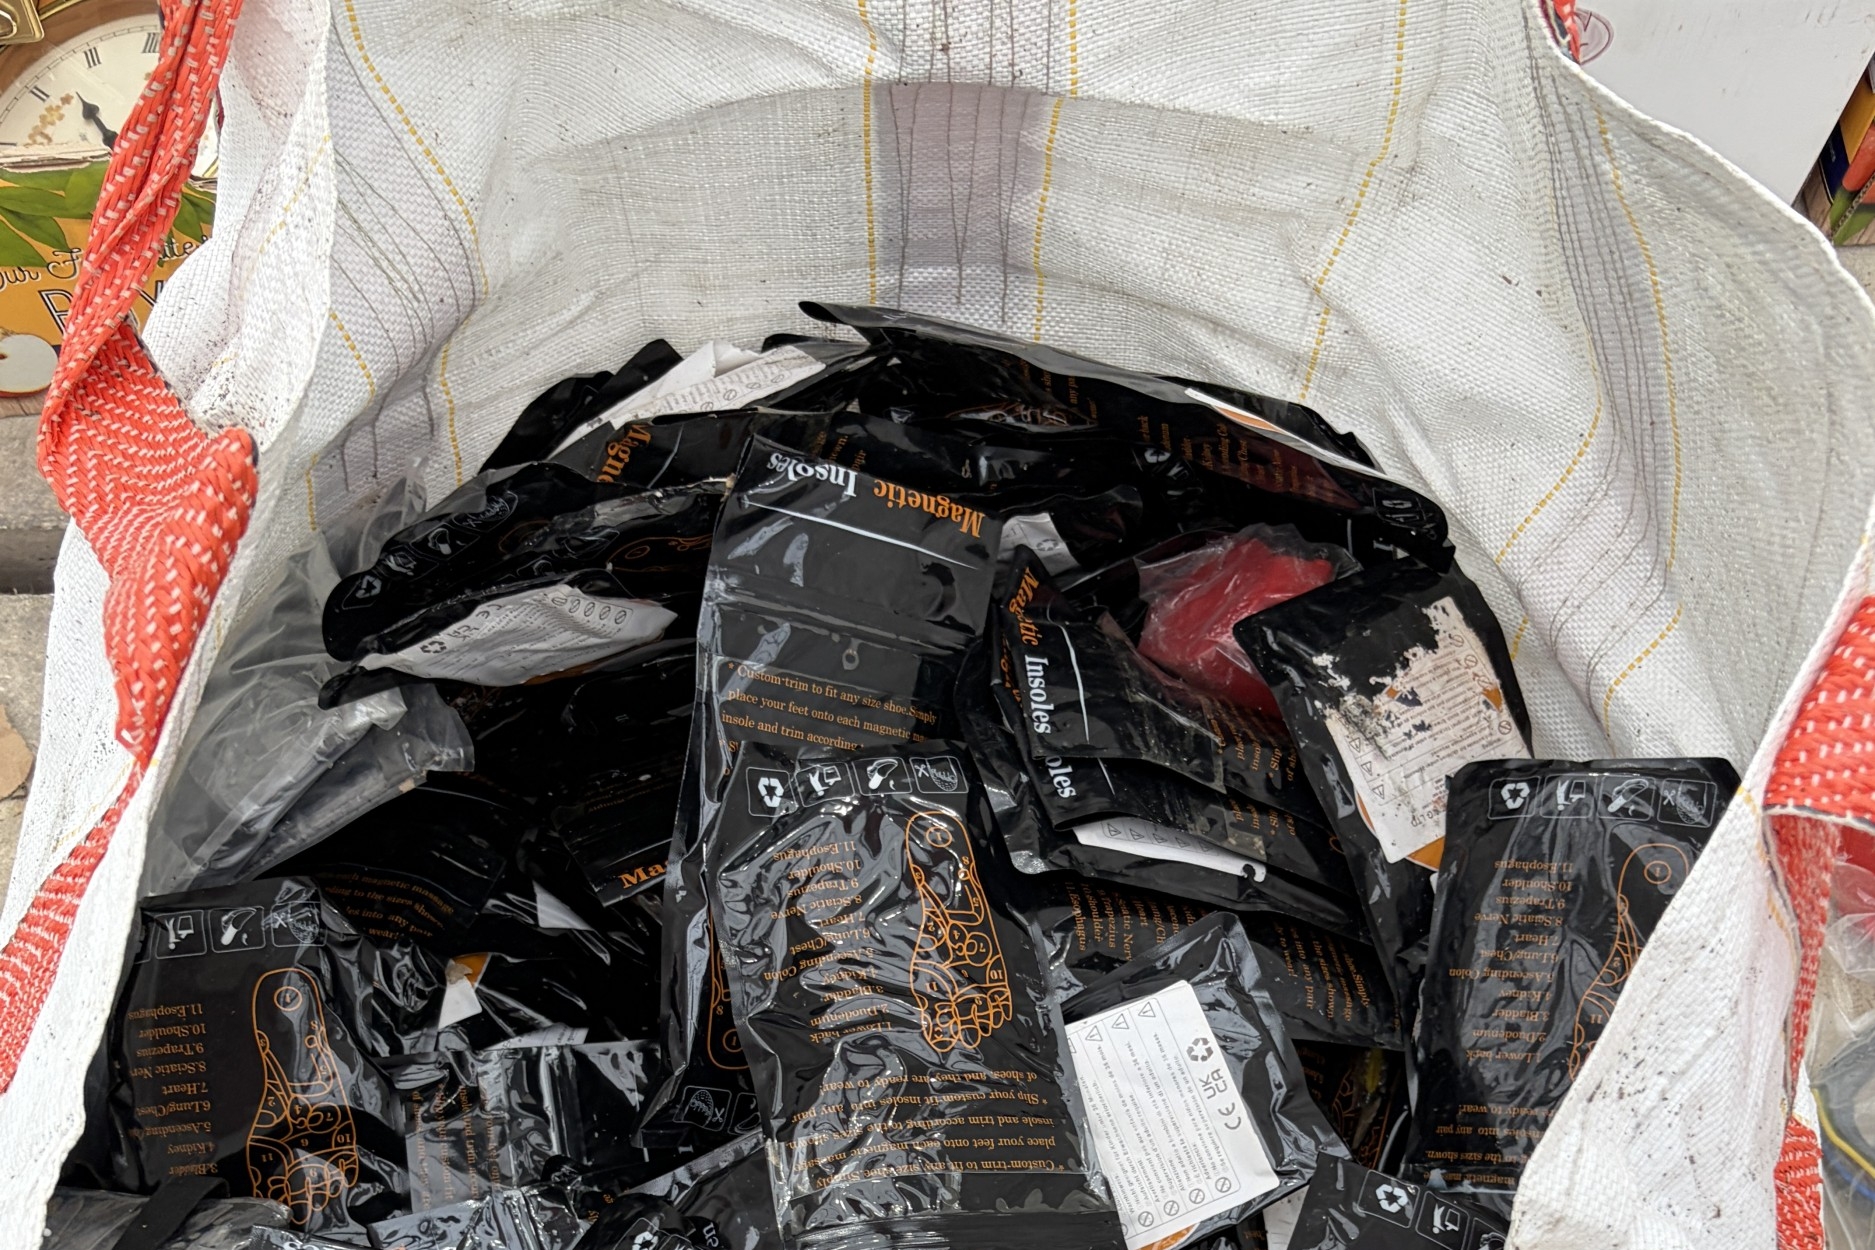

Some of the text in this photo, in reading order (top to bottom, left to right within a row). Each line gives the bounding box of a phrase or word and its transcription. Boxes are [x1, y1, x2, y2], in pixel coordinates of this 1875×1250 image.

[764, 449, 861, 497] Insoles
[872, 479, 985, 539] Magnetic
[811, 683, 824, 695] to
[824, 684, 838, 698] fit
[840, 691, 860, 704] any
[862, 696, 881, 708] size
[1025, 656, 1053, 733] Insoles
[728, 691, 911, 739] place your feet onto each magnetic
[721, 712, 858, 752] insole and trim according
[762, 965, 797, 982] Colon
[1448, 967, 1479, 978] Colon
[138, 1023, 206, 1040] 10.Shoulder
[154, 1060, 206, 1075] 8.Sciatic
[911, 1075, 931, 1083] are
[1025, 1071, 1037, 1082] of
[161, 1081, 208, 1096] 7.Heart
[1200, 1076, 1215, 1099] UK
[988, 1090, 1040, 1105] Slip your
[967, 1115, 1054, 1127] insole and trim
[943, 1135, 1056, 1151] place your feet onto
[965, 1161, 978, 1170] to
